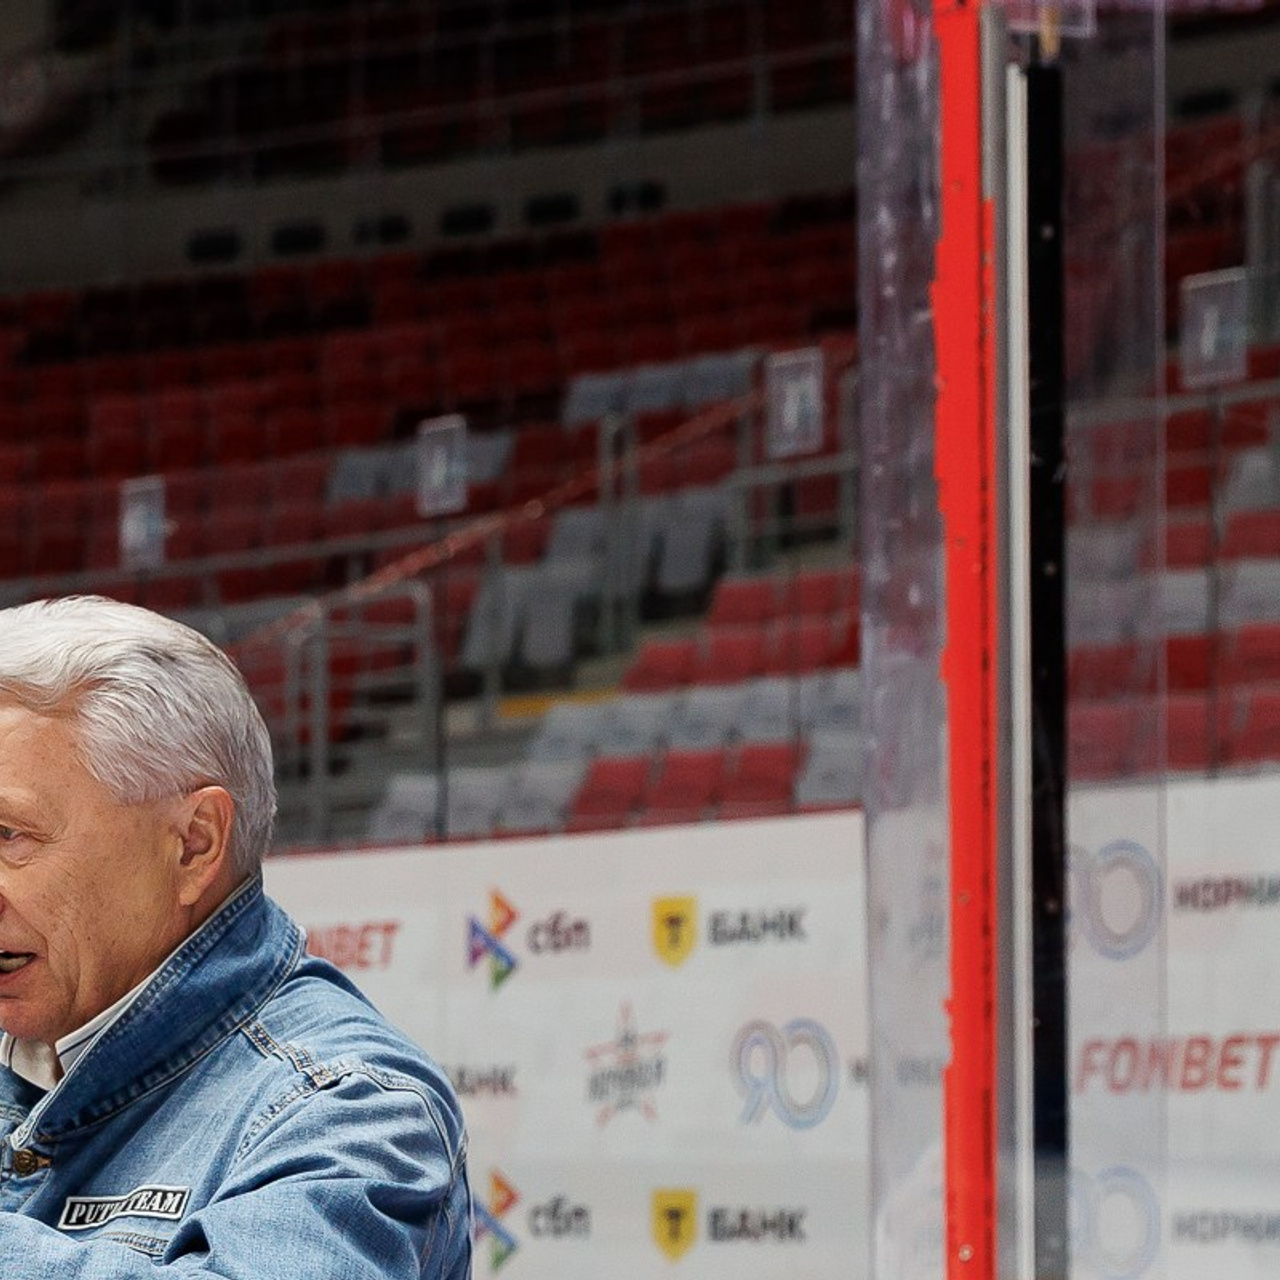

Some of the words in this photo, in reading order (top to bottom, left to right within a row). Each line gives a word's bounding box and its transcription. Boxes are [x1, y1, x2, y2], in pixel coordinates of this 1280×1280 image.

[708, 908, 809, 947] БАНК
[1074, 1031, 1280, 1095] FONBET
[708, 1203, 807, 1242] БАНК
